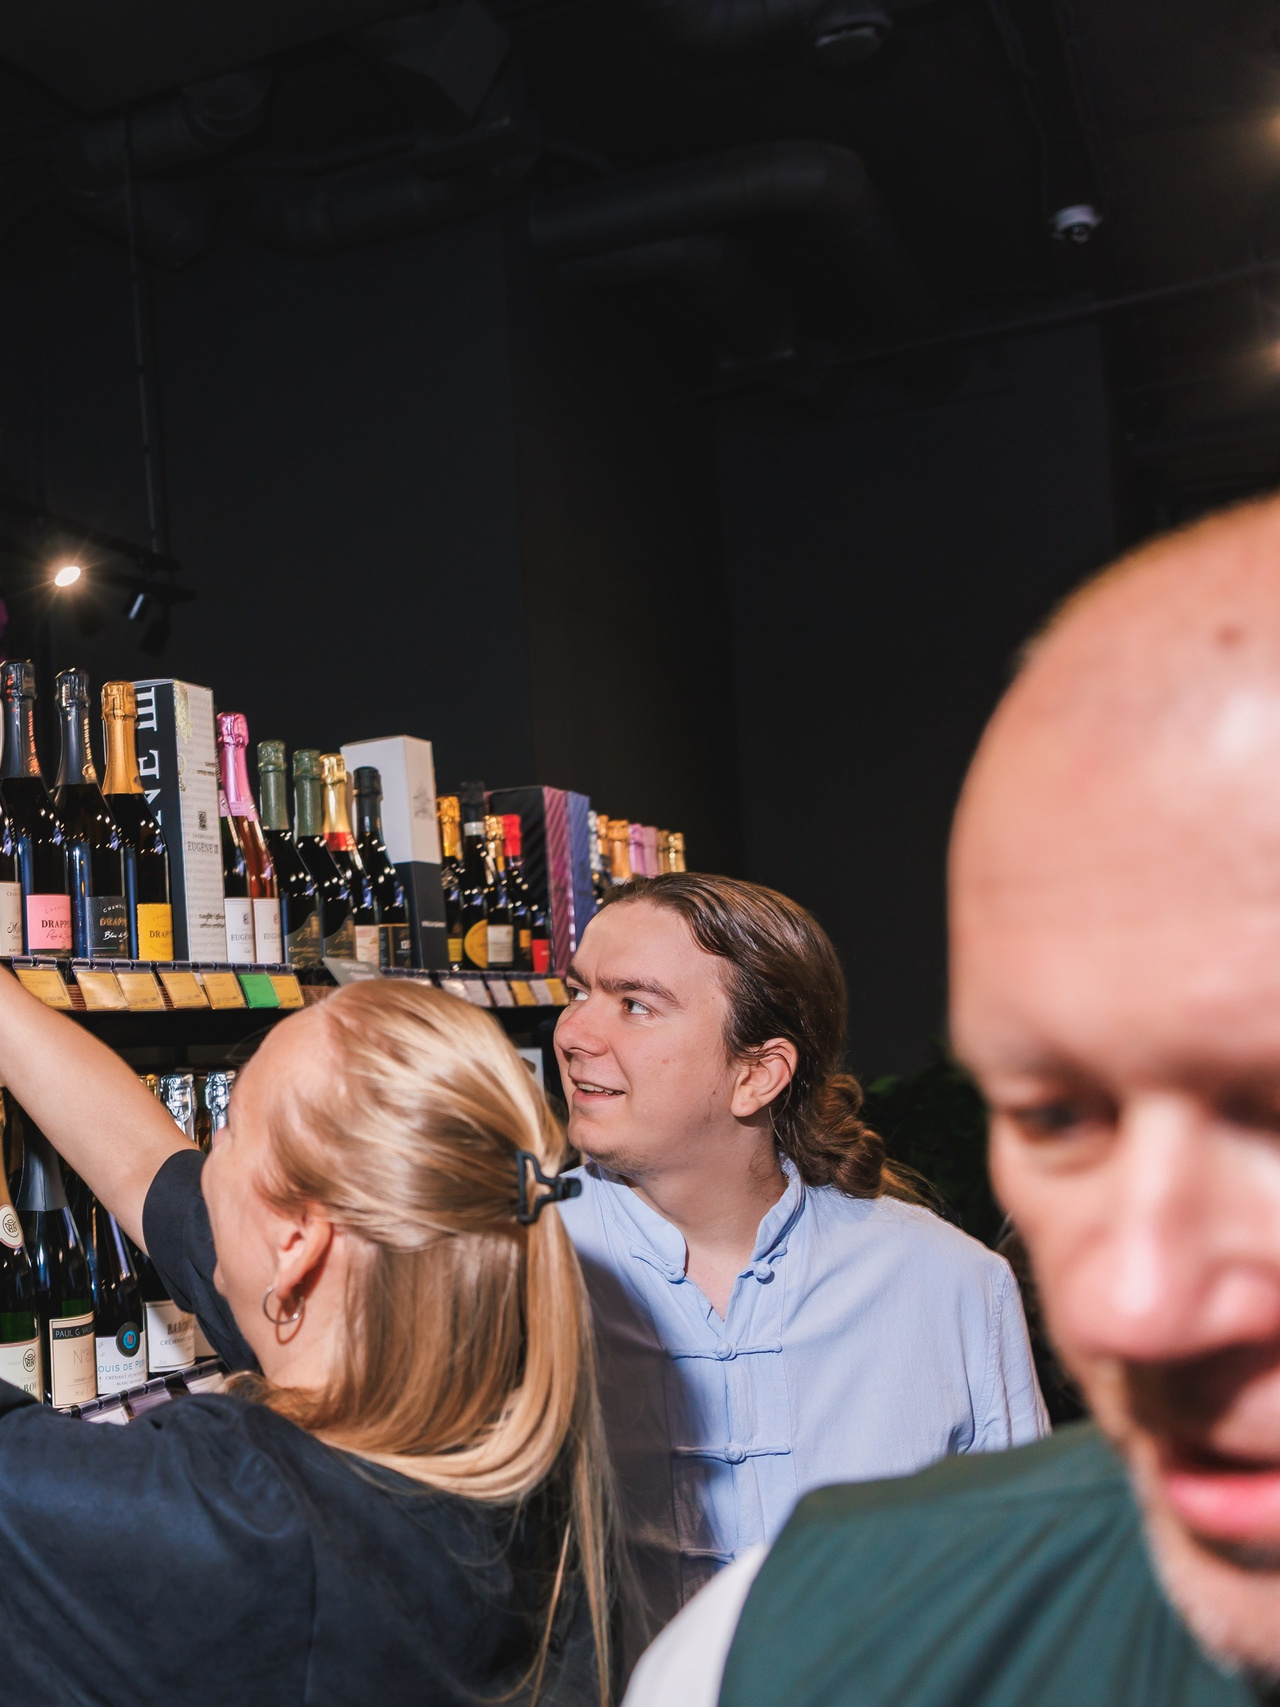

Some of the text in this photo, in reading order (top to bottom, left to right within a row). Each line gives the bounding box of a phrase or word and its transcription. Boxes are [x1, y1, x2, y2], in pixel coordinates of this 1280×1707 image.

[55, 1329, 74, 1338] PAUL
[74, 1328, 80, 1336] G
[98, 1364, 120, 1373] OUIS
[123, 1362, 133, 1371] DE
